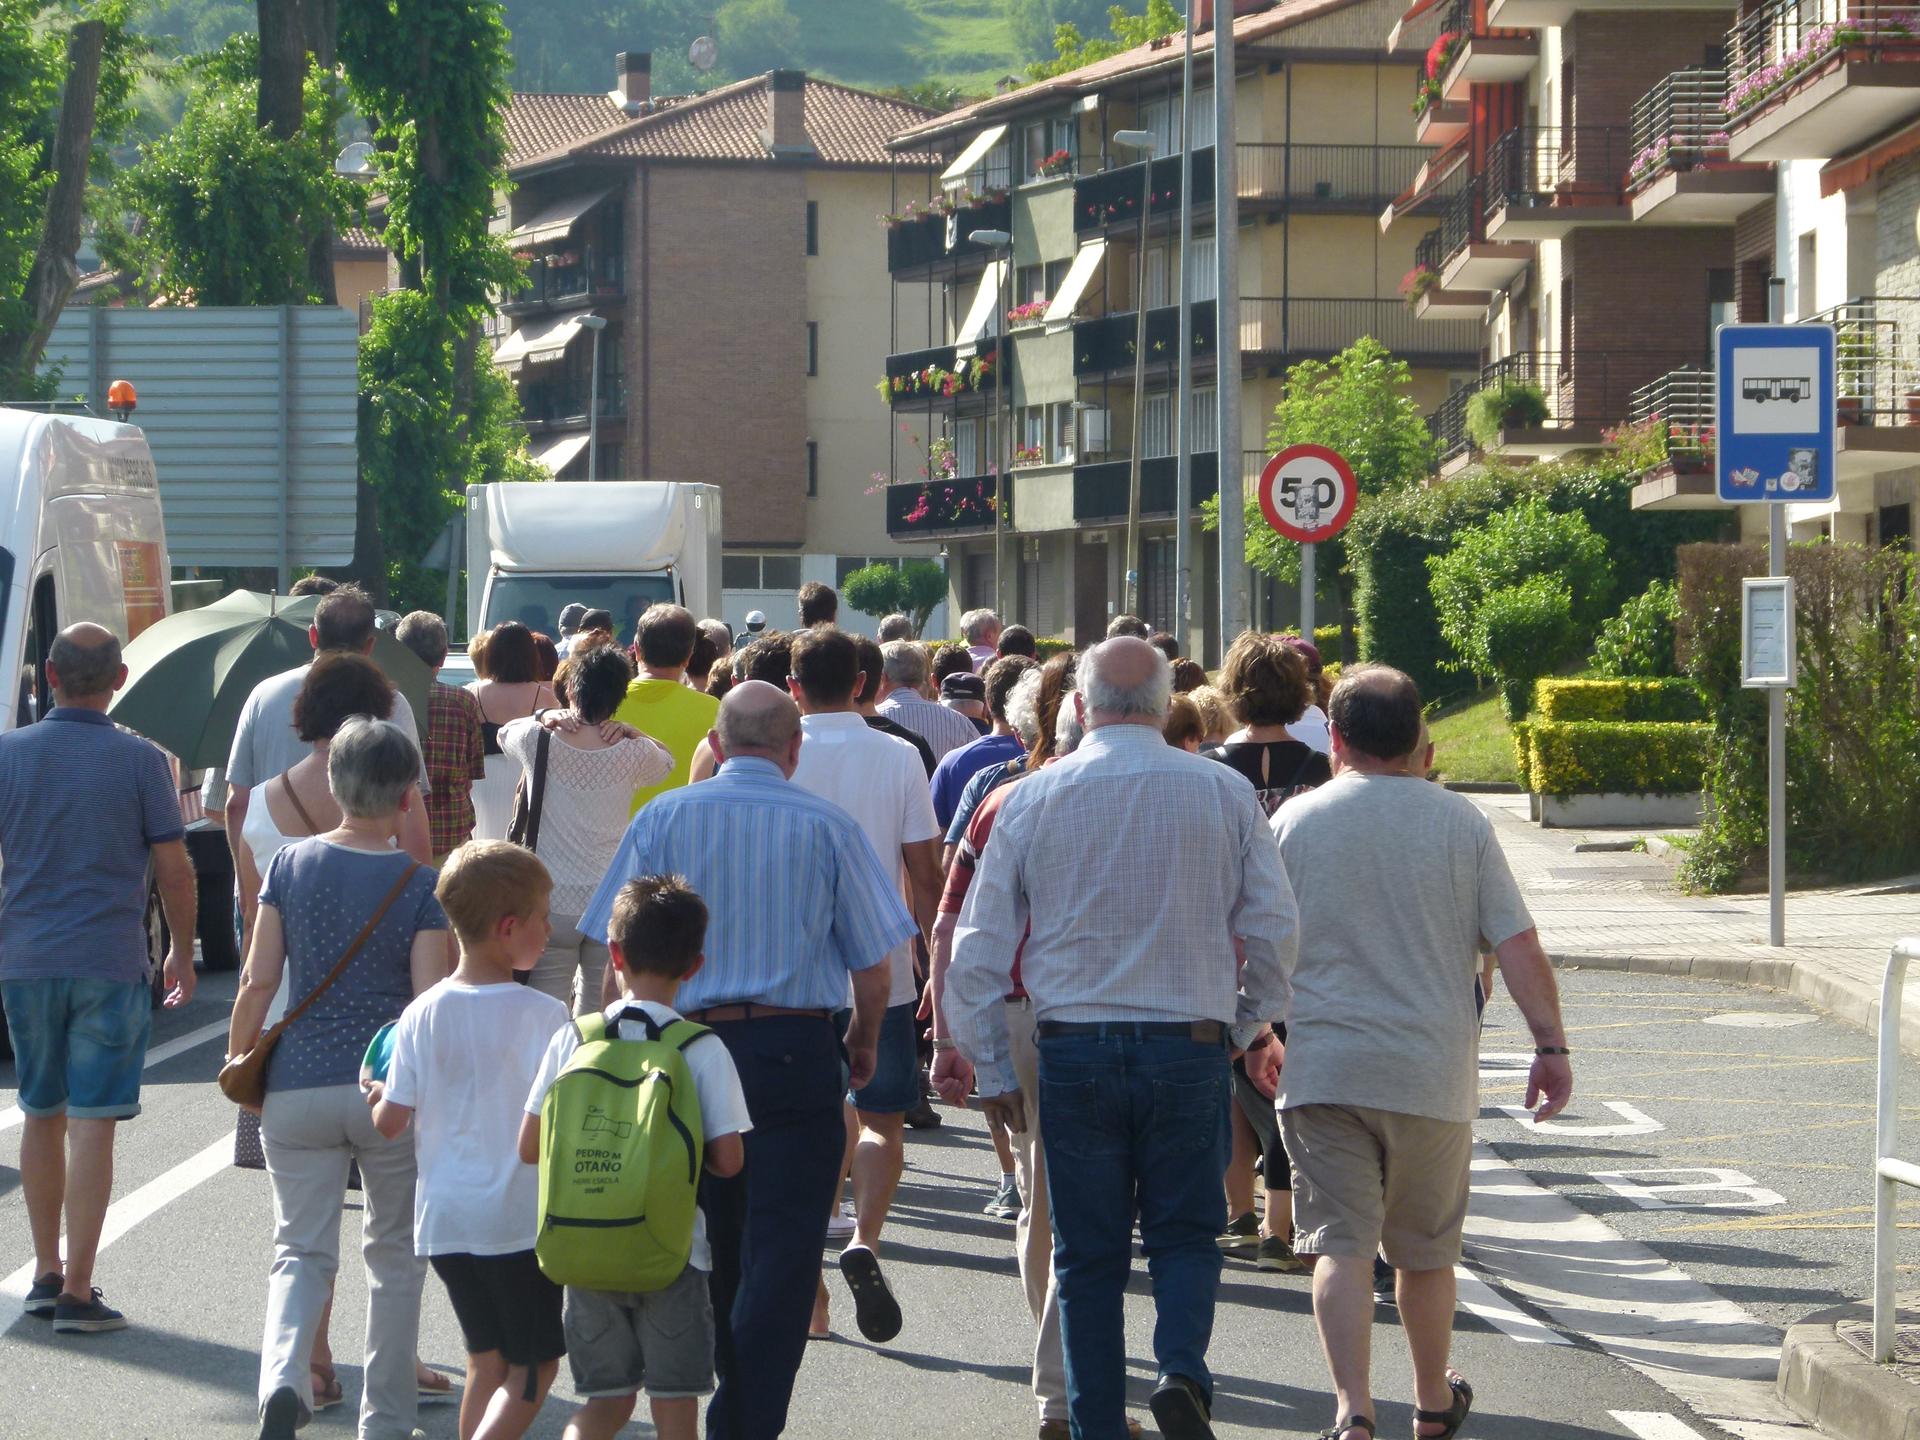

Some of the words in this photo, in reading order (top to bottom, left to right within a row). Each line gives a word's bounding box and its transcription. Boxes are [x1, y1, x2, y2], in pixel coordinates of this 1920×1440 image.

[1280, 477, 1336, 508] 50
[576, 1149, 609, 1159] PEDRO
[575, 1160, 621, 1173] OTAÑO
